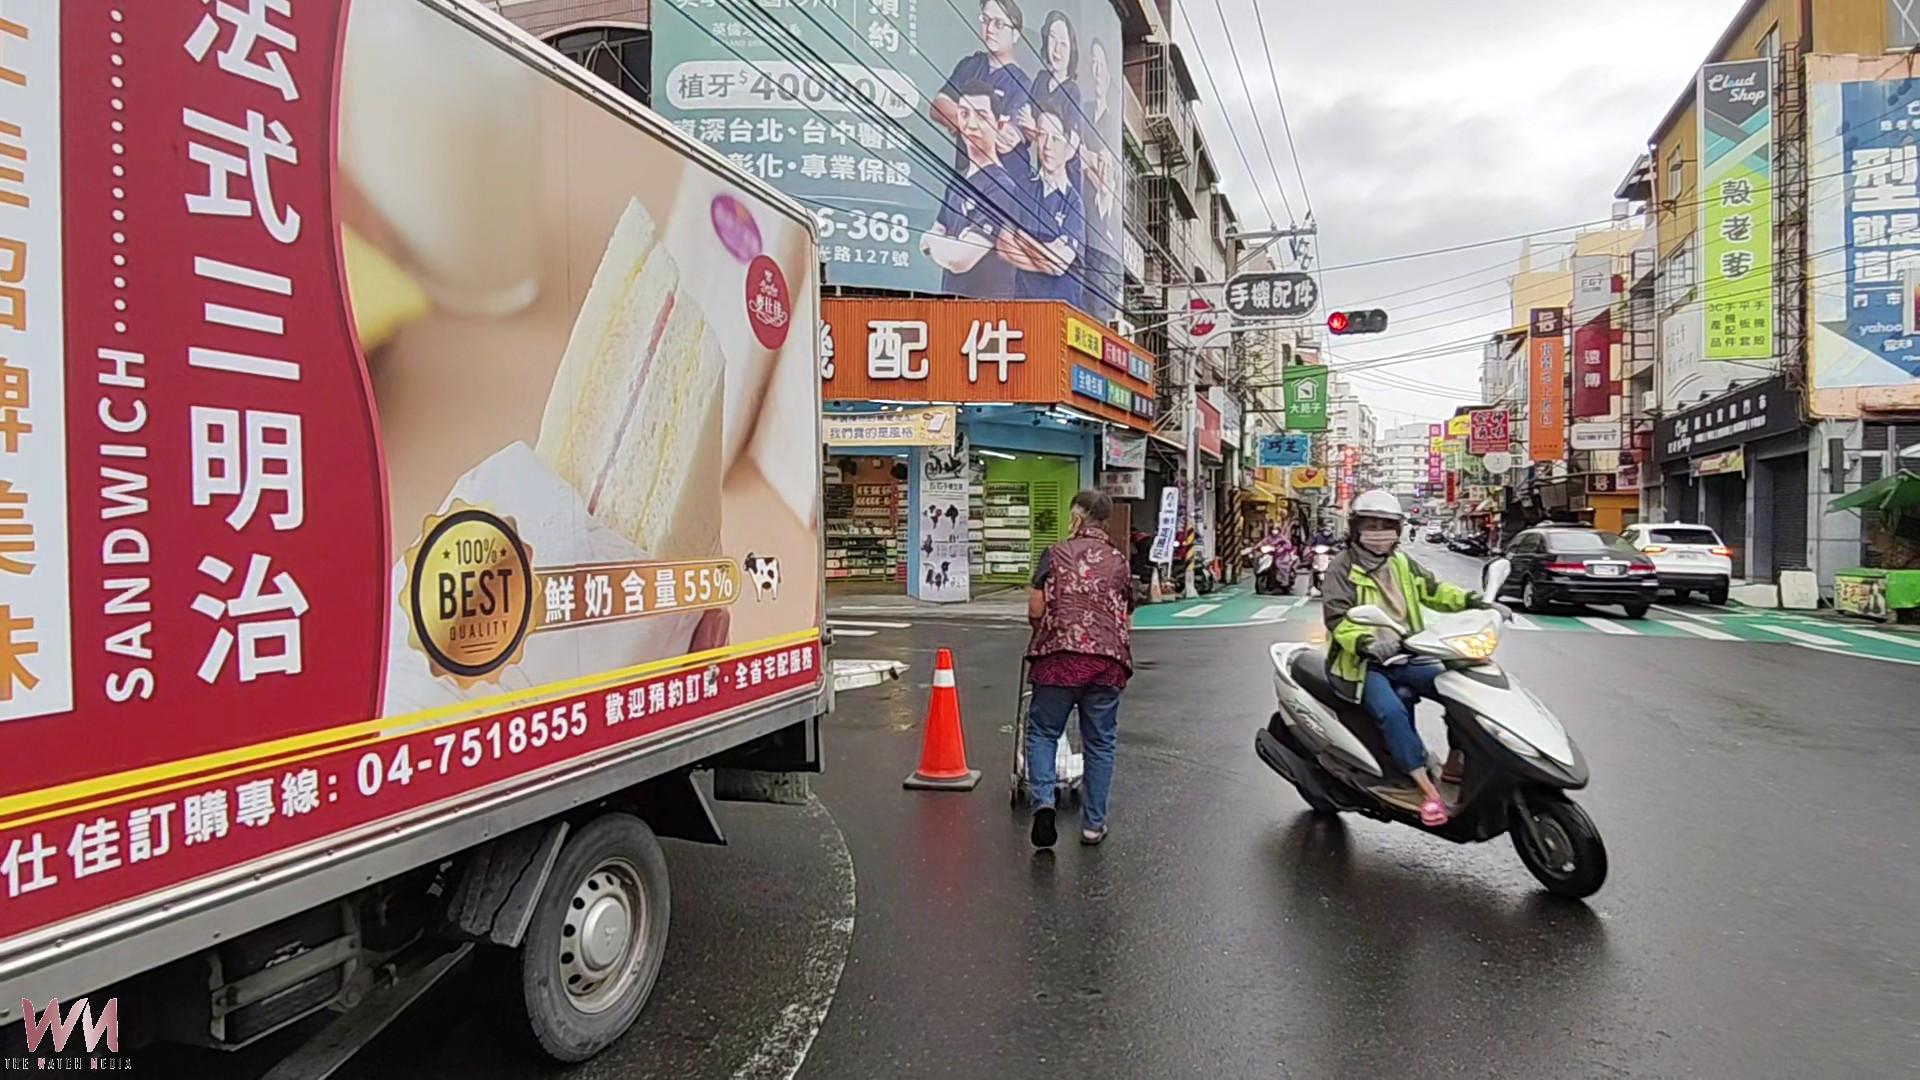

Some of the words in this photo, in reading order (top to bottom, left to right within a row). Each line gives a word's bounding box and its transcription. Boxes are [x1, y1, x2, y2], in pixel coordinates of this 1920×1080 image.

[1728, 87, 1766, 106] Shop
[1230, 279, 1314, 309] 手機配件
[183, 0, 309, 684] 法式三明治
[97, 348, 155, 703] SANDWICH
[456, 538, 498, 566] 100%
[438, 569, 513, 621] BEST
[450, 620, 509, 641] QUALITY
[357, 702, 589, 797] 04-7518555
